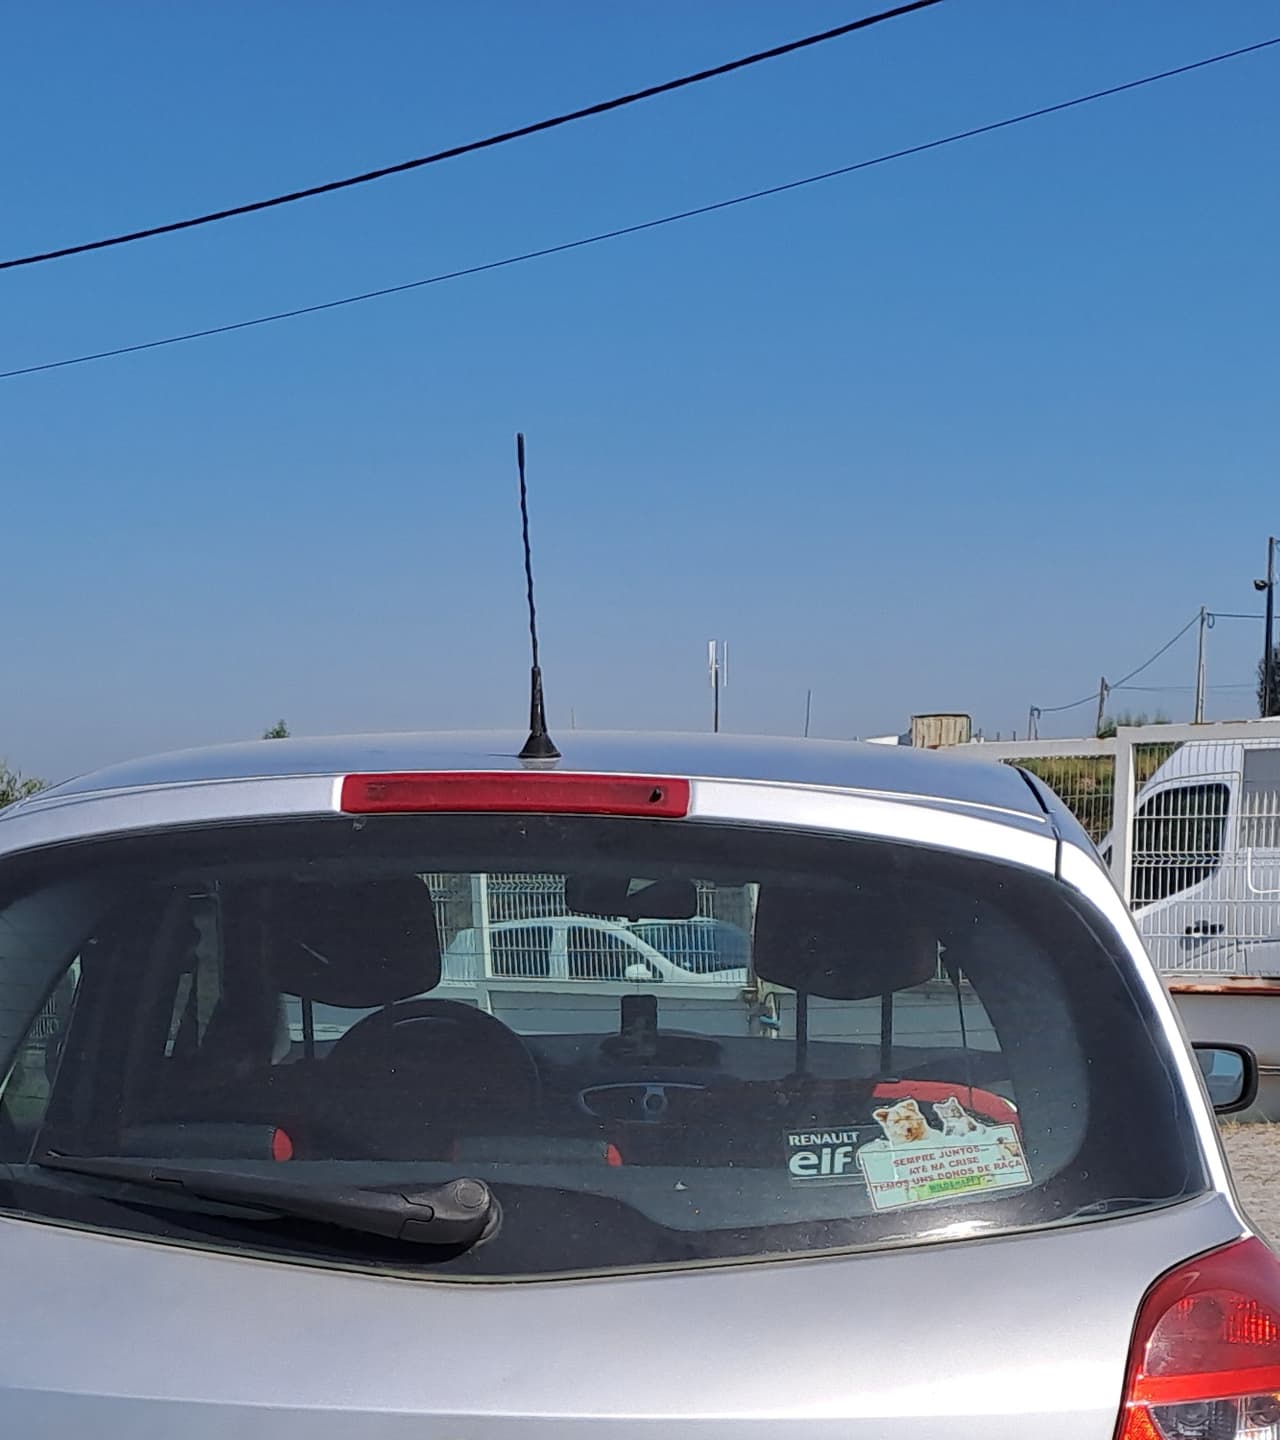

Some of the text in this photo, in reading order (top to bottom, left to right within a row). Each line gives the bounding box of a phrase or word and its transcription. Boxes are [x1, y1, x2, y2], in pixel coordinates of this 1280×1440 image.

[788, 1131, 860, 1146] RENAULT
[788, 1146, 853, 1176] elf
[893, 1153, 936, 1168] SEMPRE
[931, 1161, 945, 1172] NA
[949, 1156, 980, 1168] CRISE
[872, 1159, 1022, 1192] TEMOS UNS DONOS DE RAÇA
